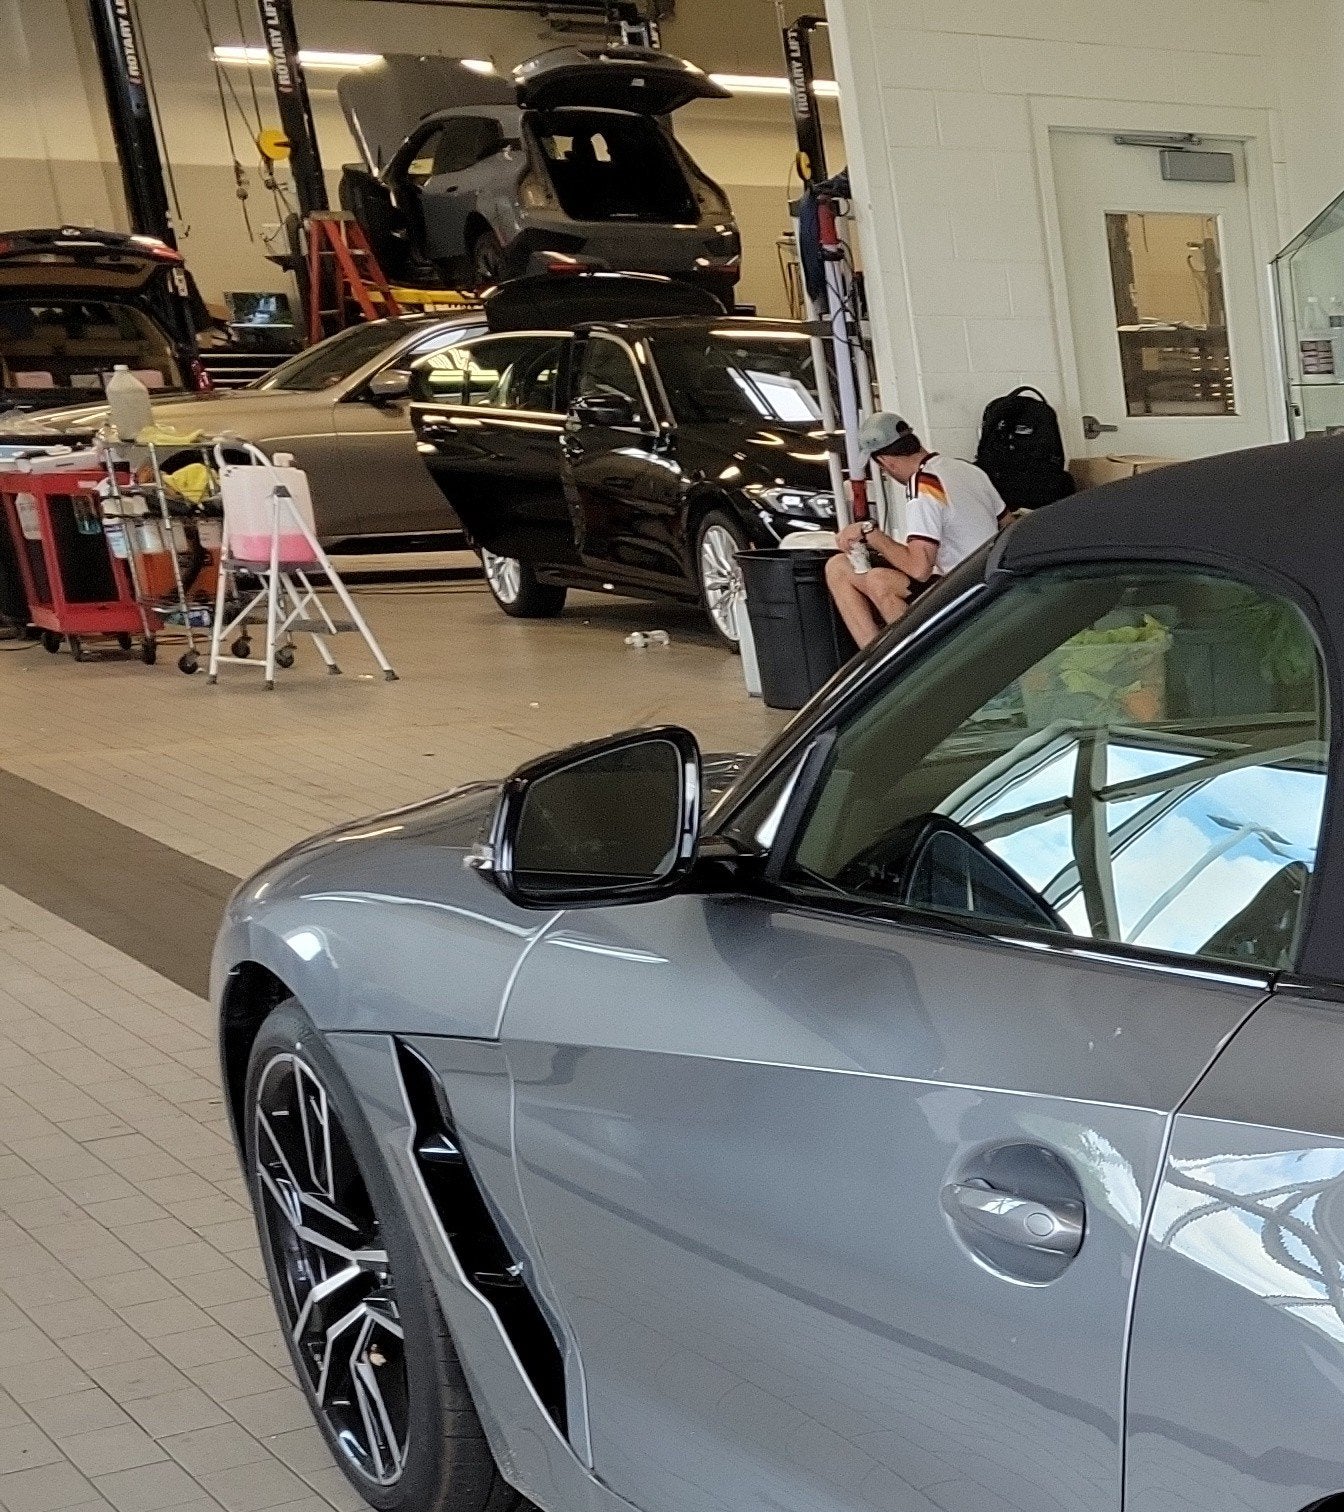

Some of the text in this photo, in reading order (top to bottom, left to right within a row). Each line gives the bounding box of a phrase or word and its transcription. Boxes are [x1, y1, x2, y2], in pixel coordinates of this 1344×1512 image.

[117, 17, 139, 77] ROTARY
[268, 28, 291, 85] ROTARY
[791, 60, 810, 112] ROTARY
